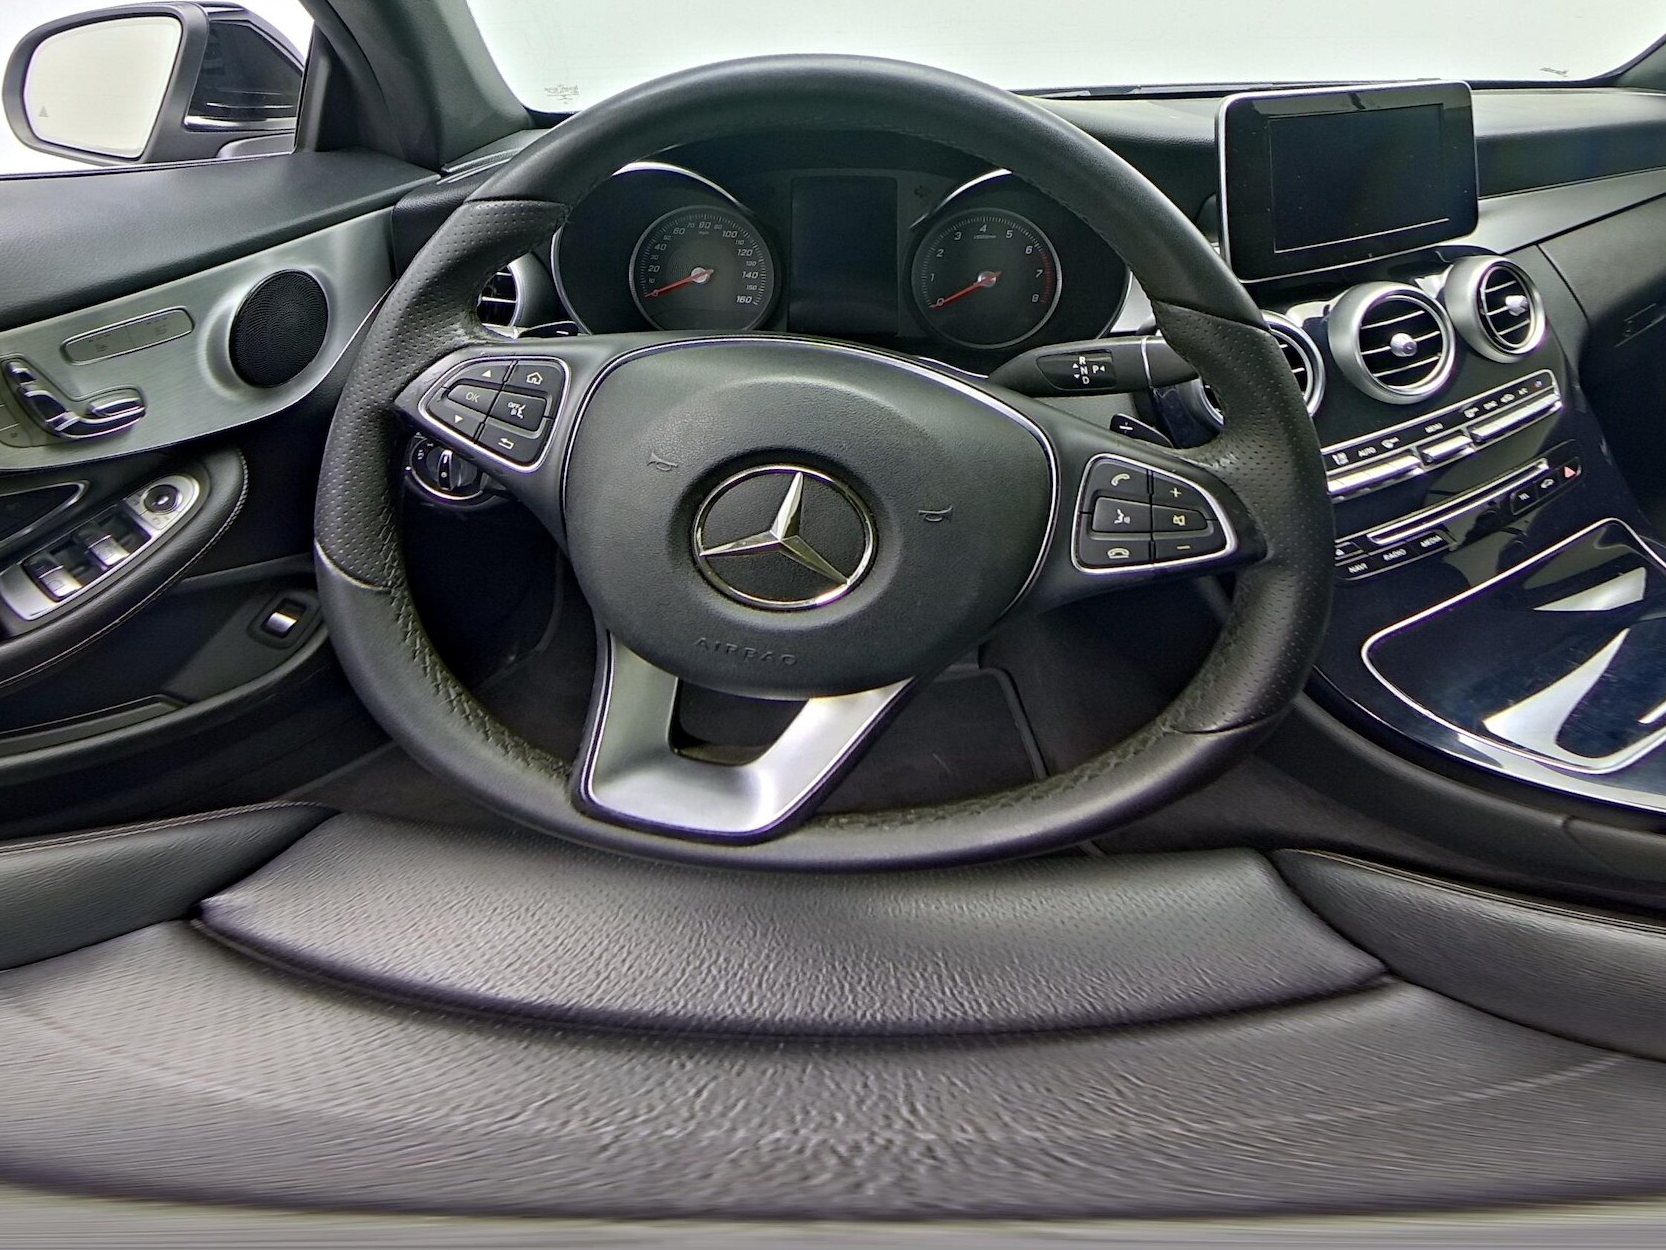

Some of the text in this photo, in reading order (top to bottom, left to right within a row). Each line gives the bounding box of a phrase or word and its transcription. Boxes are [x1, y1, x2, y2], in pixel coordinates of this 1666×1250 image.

[979, 224, 987, 232] 4
[722, 230, 738, 238] 100
[954, 232, 962, 240] 3
[1005, 230, 1013, 238] 5
[654, 243, 667, 251] 40
[1025, 245, 1033, 254] 6
[936, 249, 945, 257] 2
[742, 271, 758, 279] 140
[930, 273, 935, 281] 1
[1035, 270, 1043, 278] 7
[736, 296, 752, 304] 160
[1031, 294, 1039, 302] 8
[1079, 356, 1086, 365] R
[1080, 366, 1088, 375] N
[1092, 365, 1099, 373] P
[1082, 376, 1090, 384] D
[465, 392, 481, 403] OK
[1358, 446, 1377, 457] AUTO
[1420, 534, 1443, 548] MEDIA
[1383, 548, 1407, 561] RADIO
